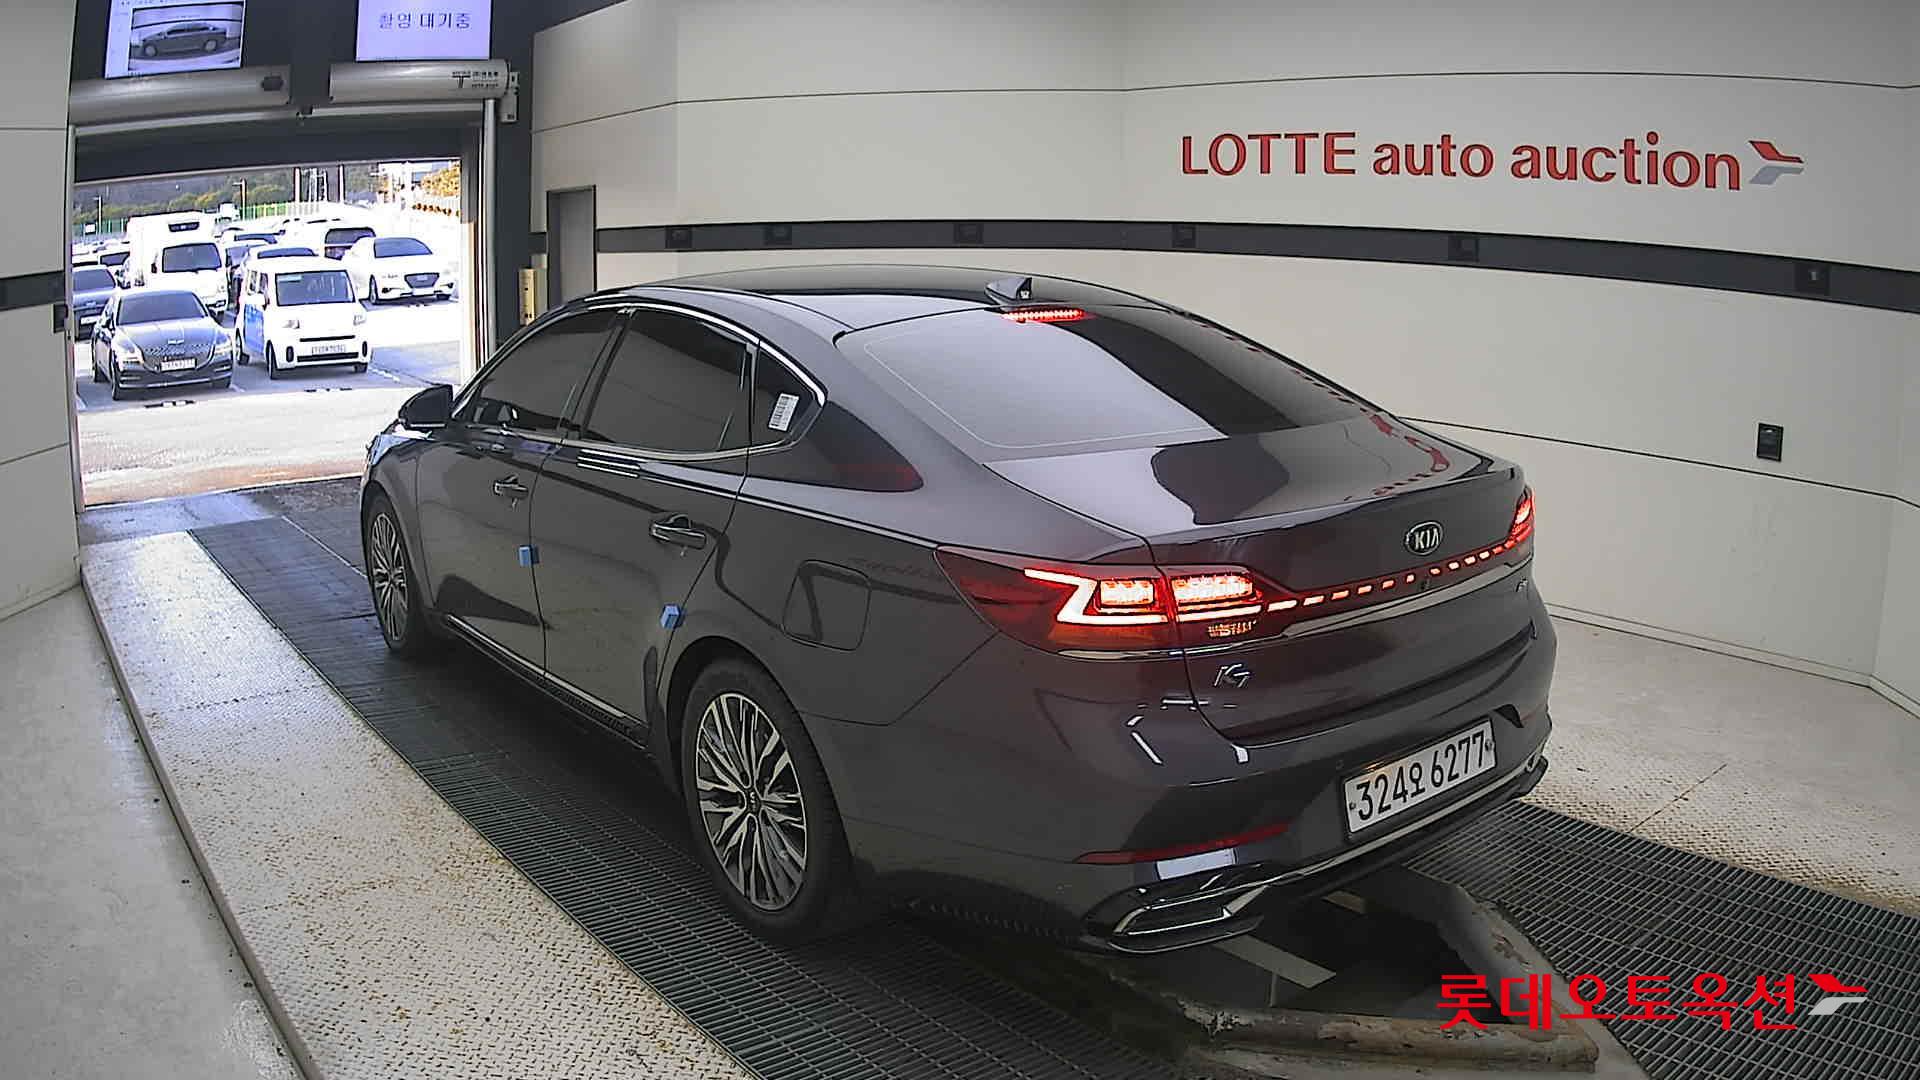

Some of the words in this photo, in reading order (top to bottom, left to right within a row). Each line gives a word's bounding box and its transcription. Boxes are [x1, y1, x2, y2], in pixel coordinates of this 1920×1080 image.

[419, 12, 472, 30] 대기중
[1182, 132, 1356, 176] LOTTE
[1373, 134, 1495, 177] auto
[1510, 131, 1742, 191] auction
[1356, 762, 1426, 821] 324오
[1430, 729, 1485, 788] 6277
